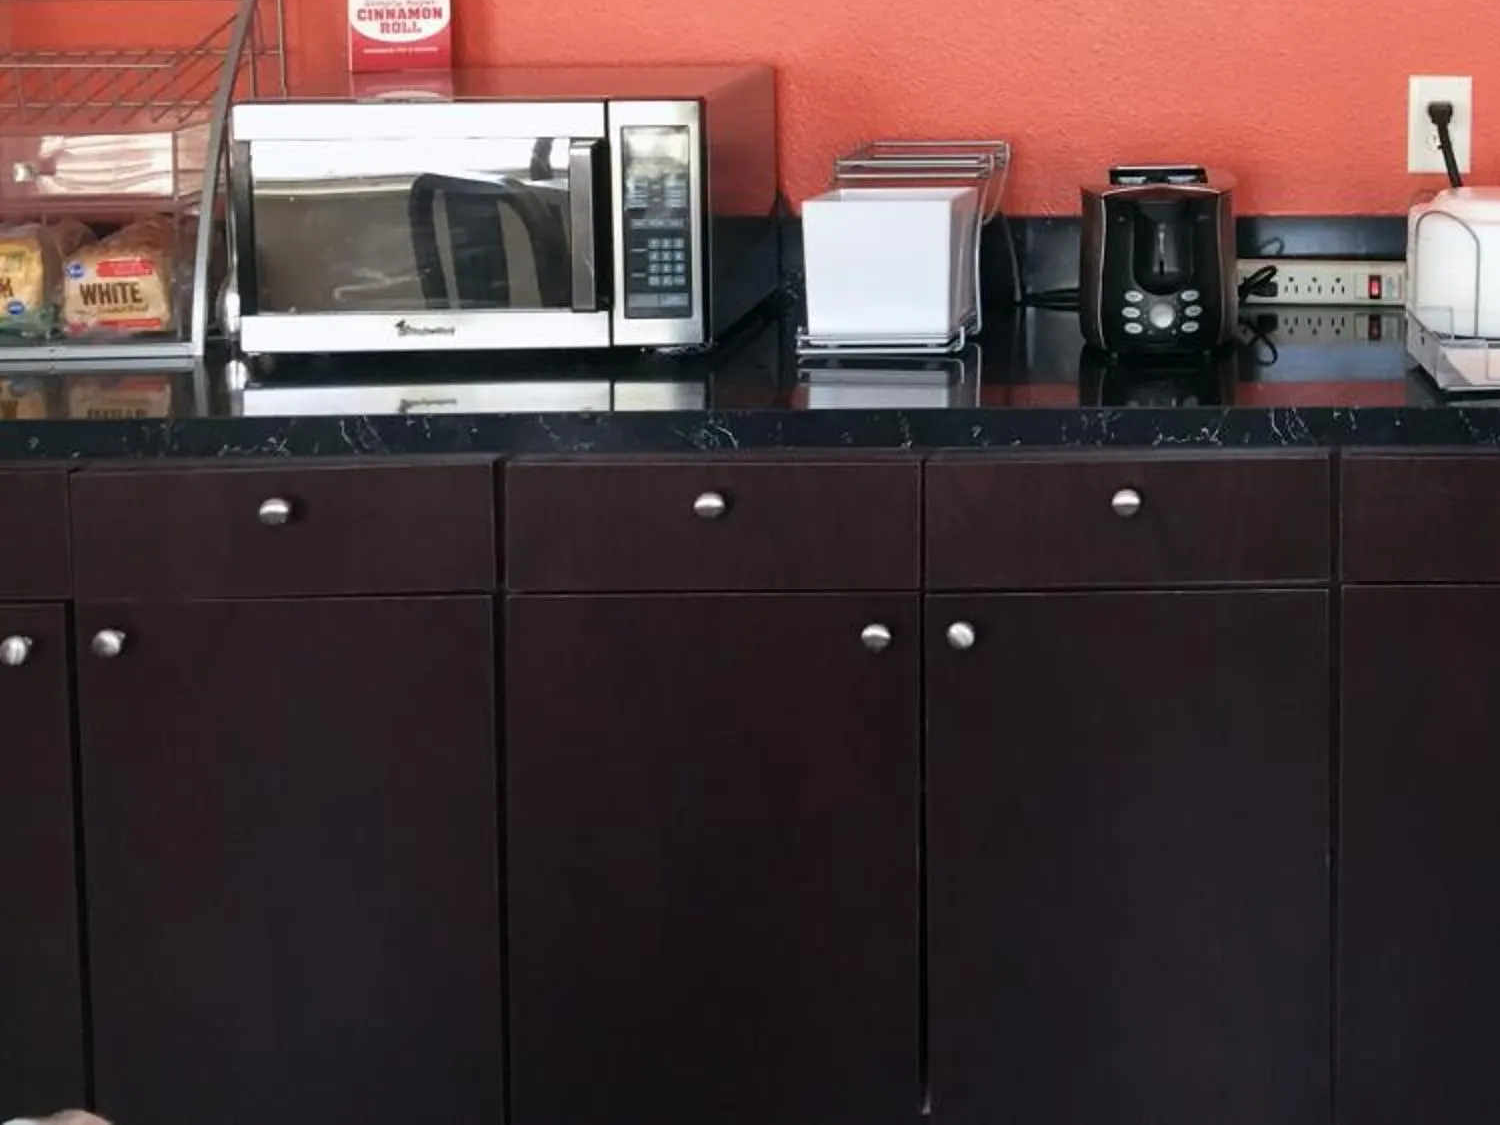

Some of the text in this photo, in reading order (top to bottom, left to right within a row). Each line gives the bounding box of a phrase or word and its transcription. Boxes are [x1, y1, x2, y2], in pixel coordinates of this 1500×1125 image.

[357, 6, 443, 22] CINNAMON
[380, 21, 422, 34] ROLL
[80, 282, 143, 306] WHITE
